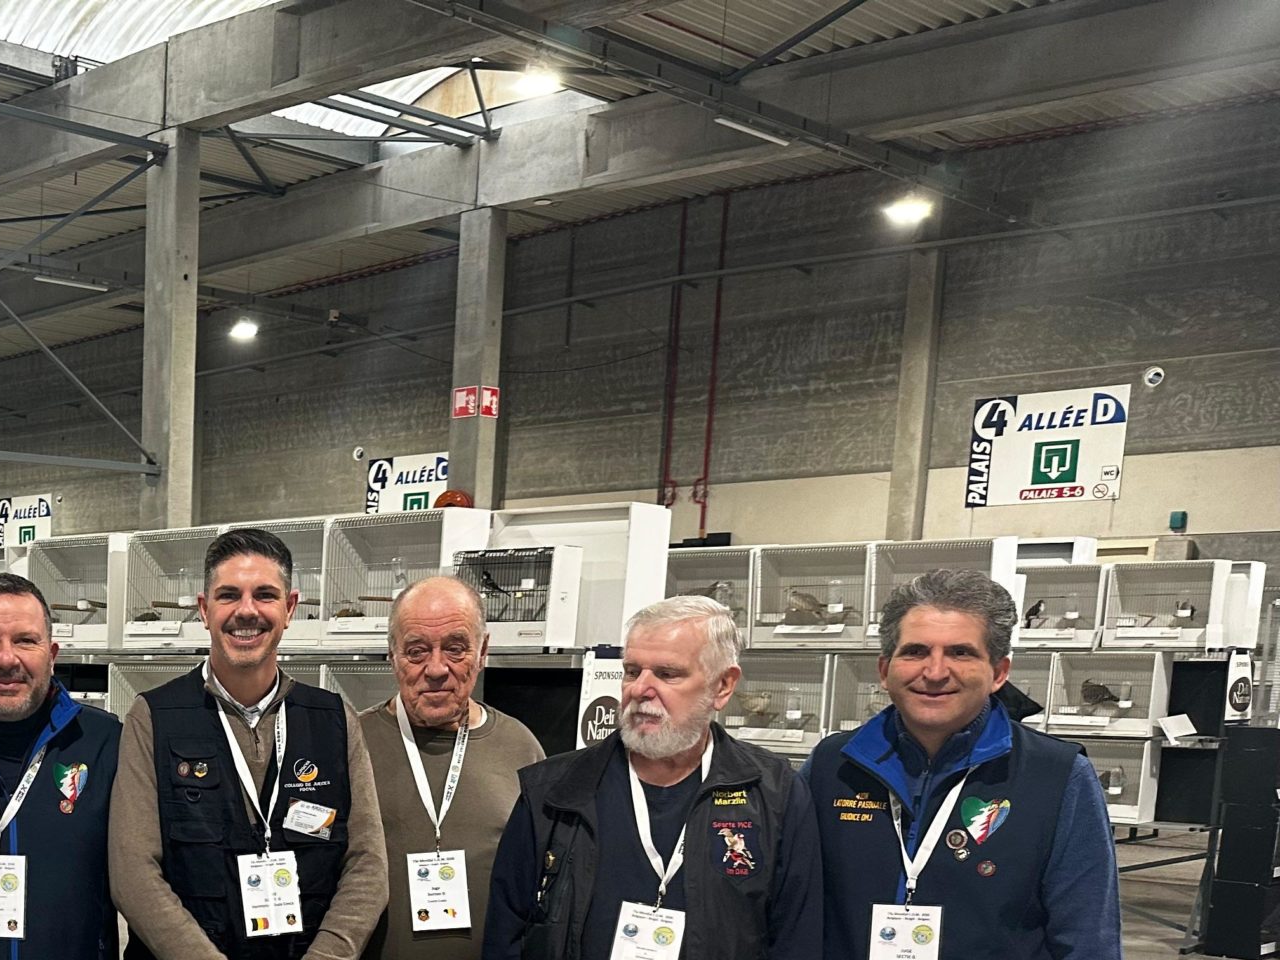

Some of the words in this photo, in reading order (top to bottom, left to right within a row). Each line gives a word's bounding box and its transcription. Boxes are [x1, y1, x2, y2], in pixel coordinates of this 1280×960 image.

[1017, 405, 1088, 432] ALLÉE
[1094, 398, 1116, 423] D
[967, 441, 992, 505] PALAIS
[981, 402, 1008, 437] 4
[372, 463, 388, 490] 4
[394, 466, 435, 485] ALLÉE
[436, 461, 448, 480] C
[1103, 468, 1115, 477] WC
[366, 491, 379, 514] AIS
[1021, 488, 1059, 499] PALAIS
[1062, 486, 1084, 497] 5-6
[0, 502, 9, 524] 4
[12, 505, 38, 520] ALLÉE
[39, 501, 48, 516] B
[594, 671, 623, 680] SPONSOR
[593, 705, 616, 725] Deli
[587, 720, 617, 740] Natu
